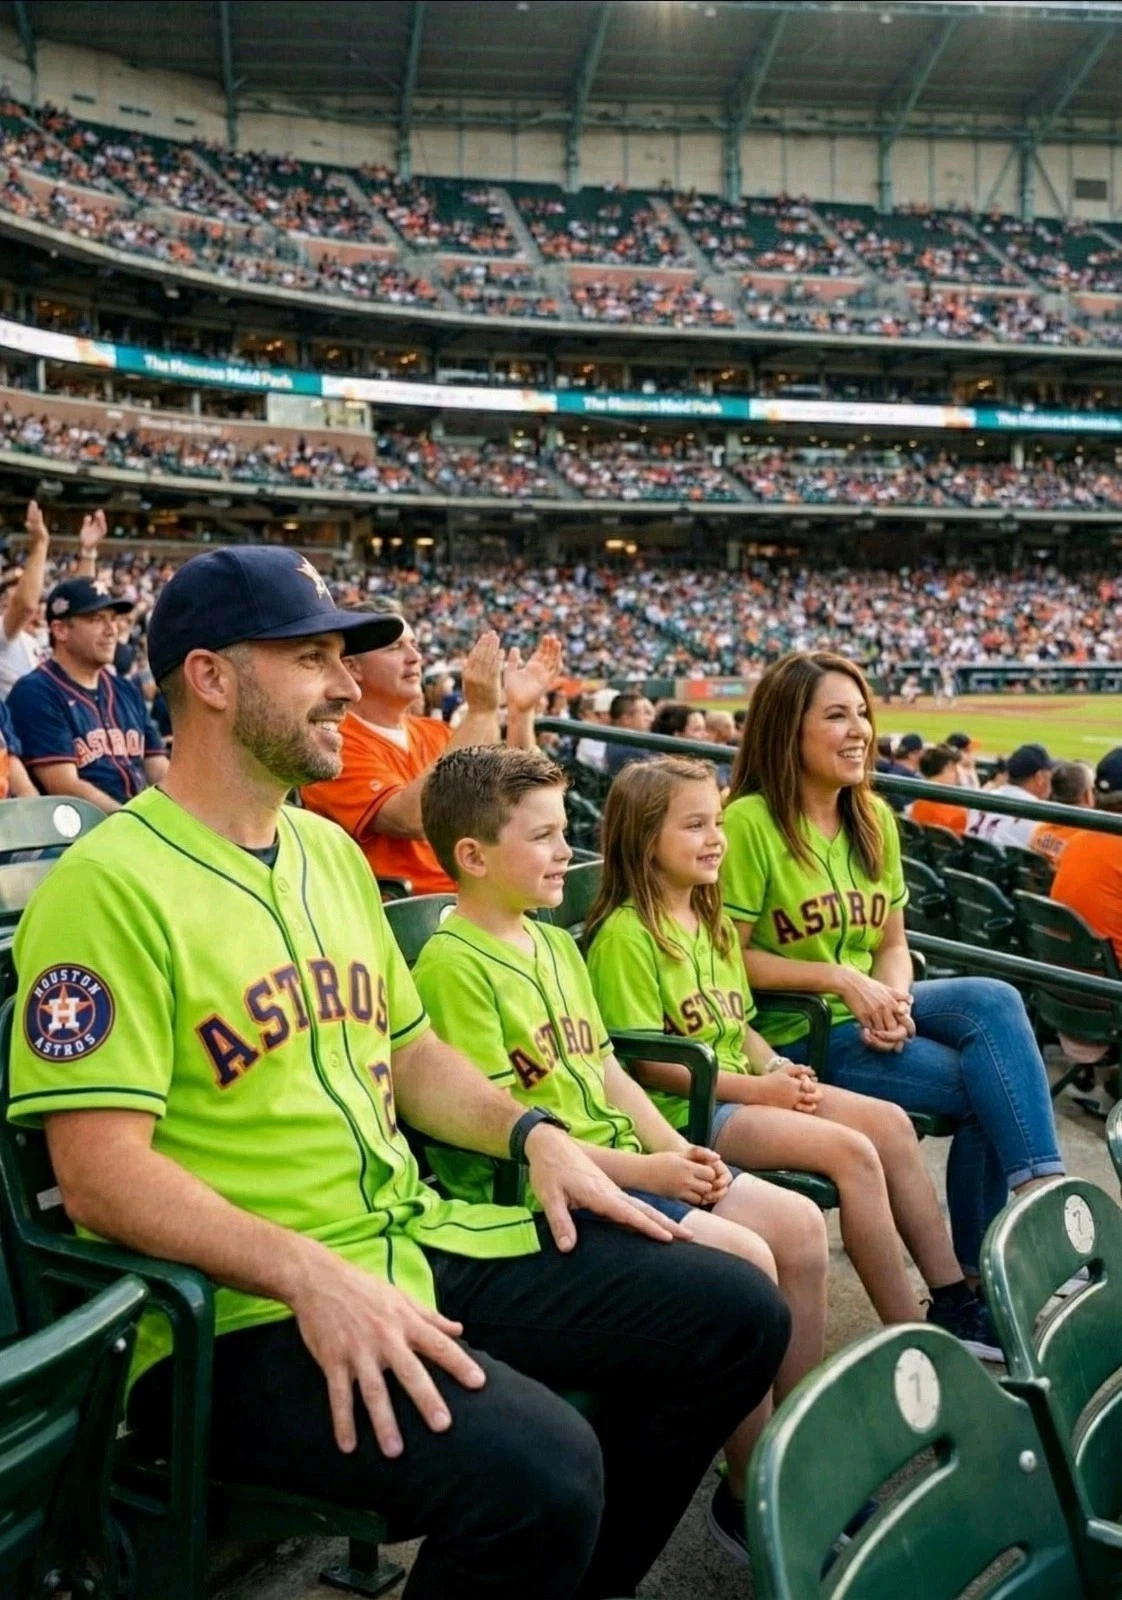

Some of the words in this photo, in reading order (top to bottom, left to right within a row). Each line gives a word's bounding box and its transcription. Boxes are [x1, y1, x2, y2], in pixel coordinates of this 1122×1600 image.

[144, 354, 169, 372] The
[583, 396, 606, 411] The
[770, 890, 888, 945] ASTRO
[34, 969, 101, 998] HOUSTON
[48, 997, 80, 1031] H
[34, 1033, 96, 1056] ASTROS
